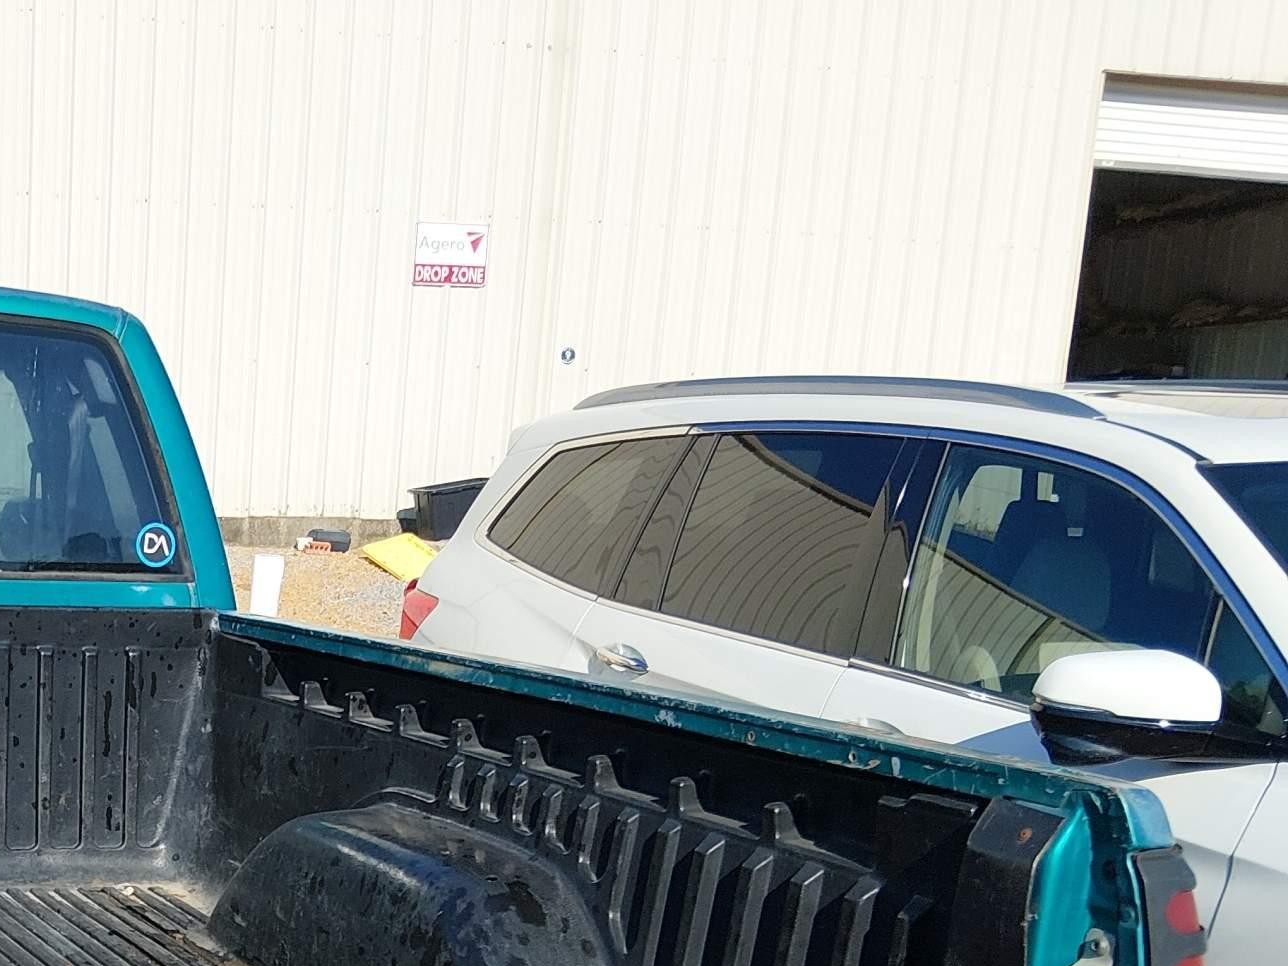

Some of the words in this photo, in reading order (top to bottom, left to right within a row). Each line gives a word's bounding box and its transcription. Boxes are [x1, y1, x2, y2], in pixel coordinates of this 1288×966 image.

[419, 236, 465, 253] Agero
[415, 265, 450, 283] DROP
[451, 266, 485, 284] ZONE
